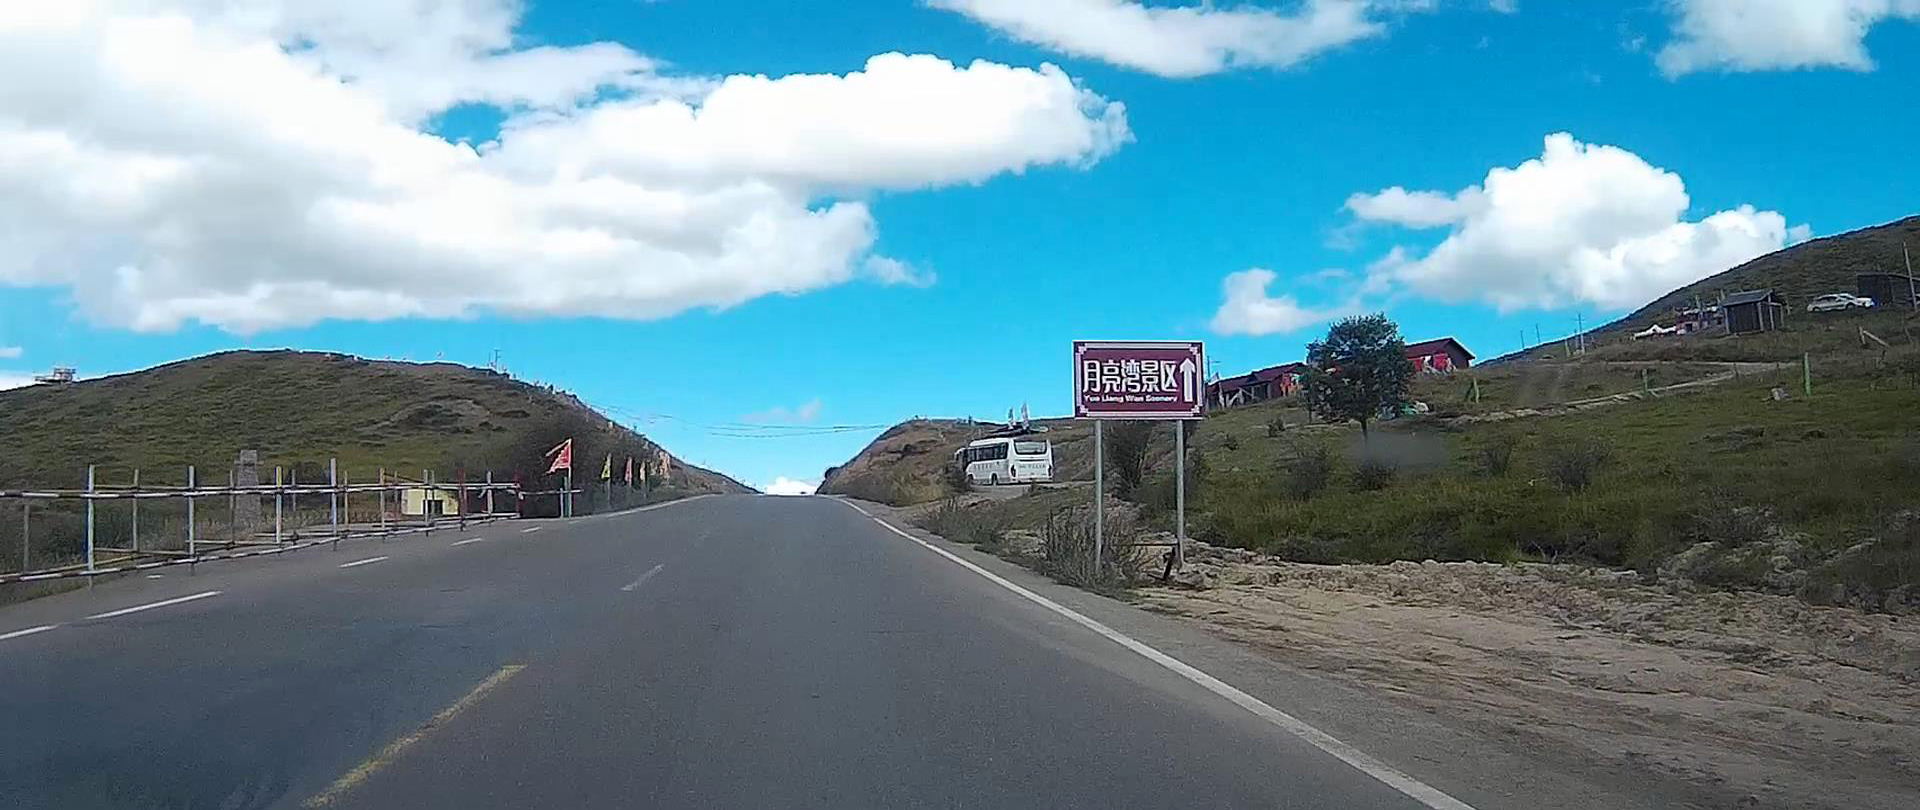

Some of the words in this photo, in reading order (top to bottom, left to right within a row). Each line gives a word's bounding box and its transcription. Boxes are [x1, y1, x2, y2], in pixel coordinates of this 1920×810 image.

[1083, 359, 1178, 392] 月亮湾景区
[1102, 394, 1123, 403] Liang
[1125, 394, 1144, 402] Wan
